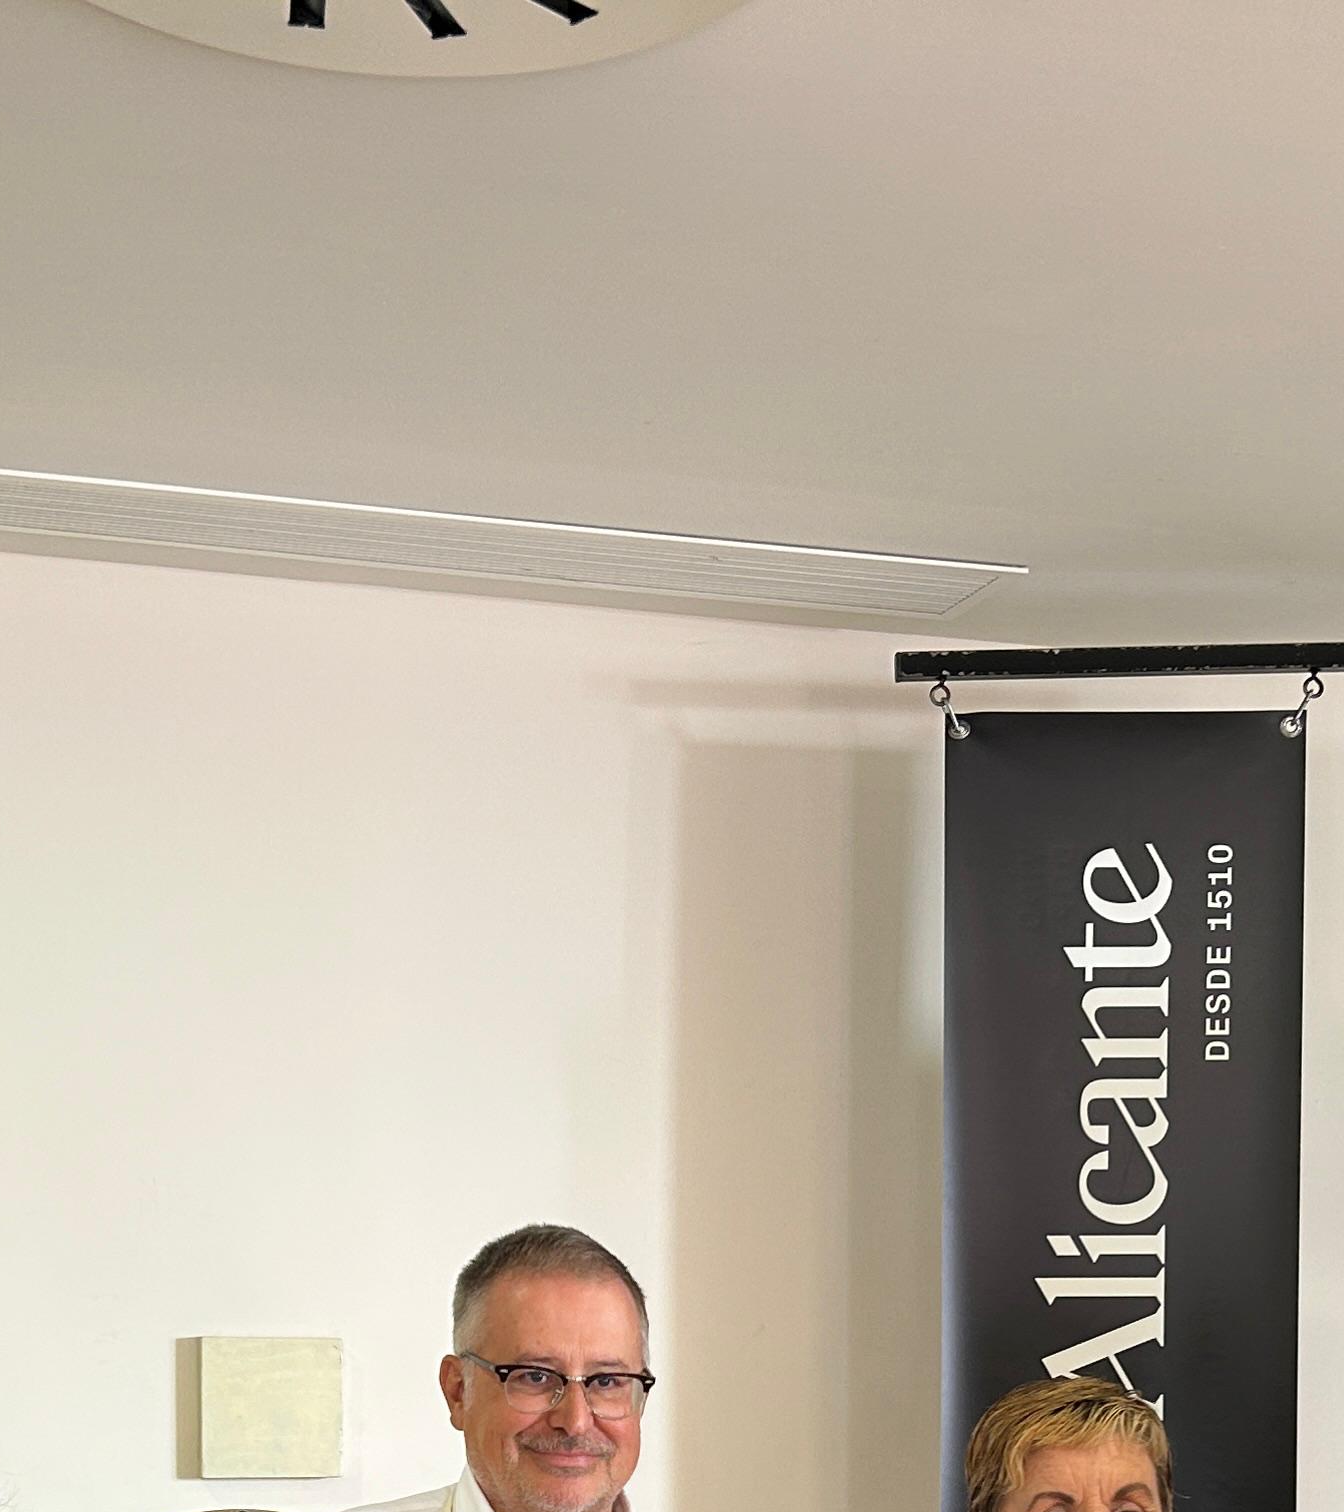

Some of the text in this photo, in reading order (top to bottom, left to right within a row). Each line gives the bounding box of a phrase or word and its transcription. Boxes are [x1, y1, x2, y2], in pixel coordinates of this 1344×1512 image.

[1034, 842, 1174, 1422] Alicante
[1204, 844, 1234, 1061] DESDE 1510
